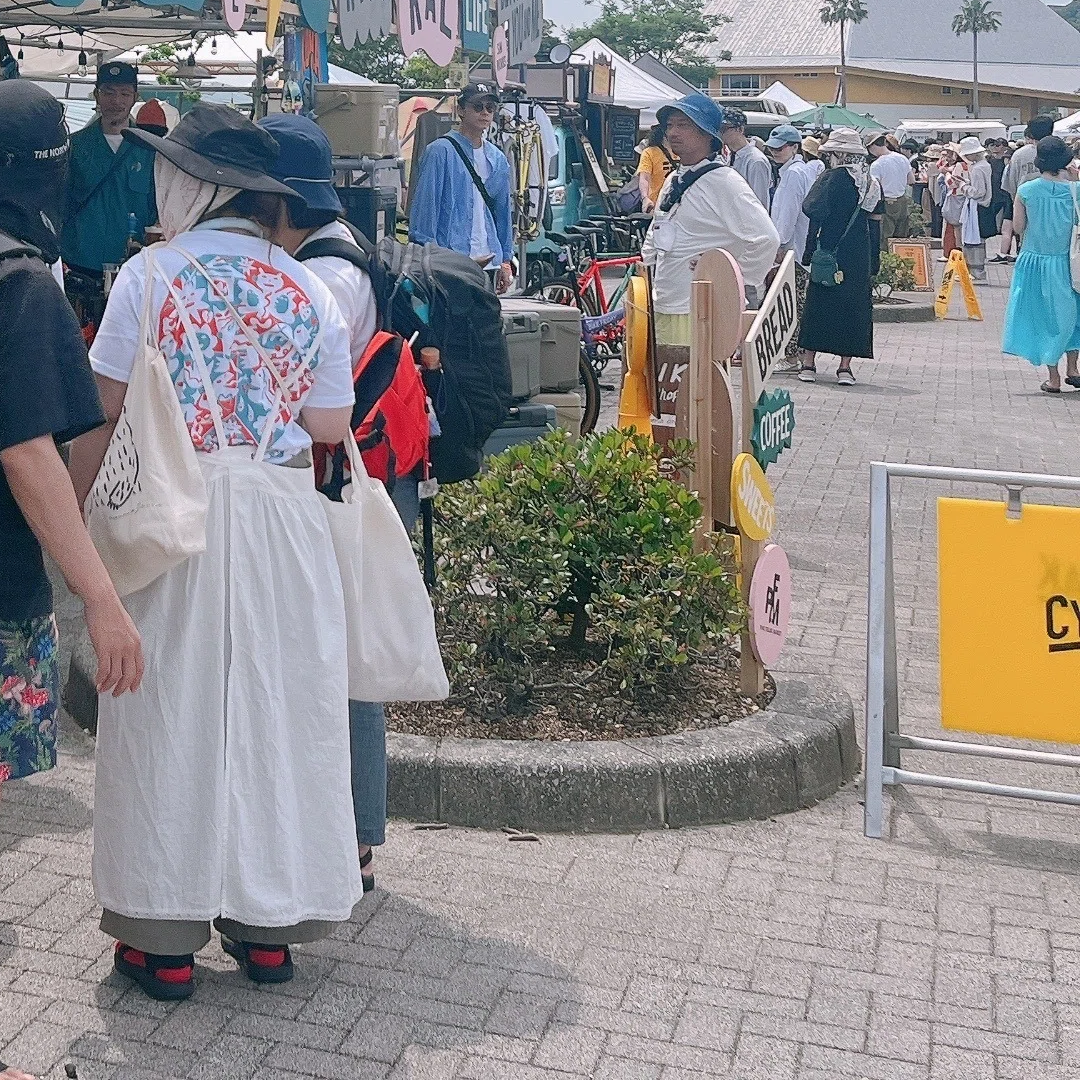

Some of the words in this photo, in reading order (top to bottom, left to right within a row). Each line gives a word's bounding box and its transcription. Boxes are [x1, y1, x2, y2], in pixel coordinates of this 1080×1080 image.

[33, 149, 49, 159] THE
[754, 281, 795, 383] BREAD
[759, 403, 791, 452] COFFEE
[737, 459, 775, 534] SWEETS
